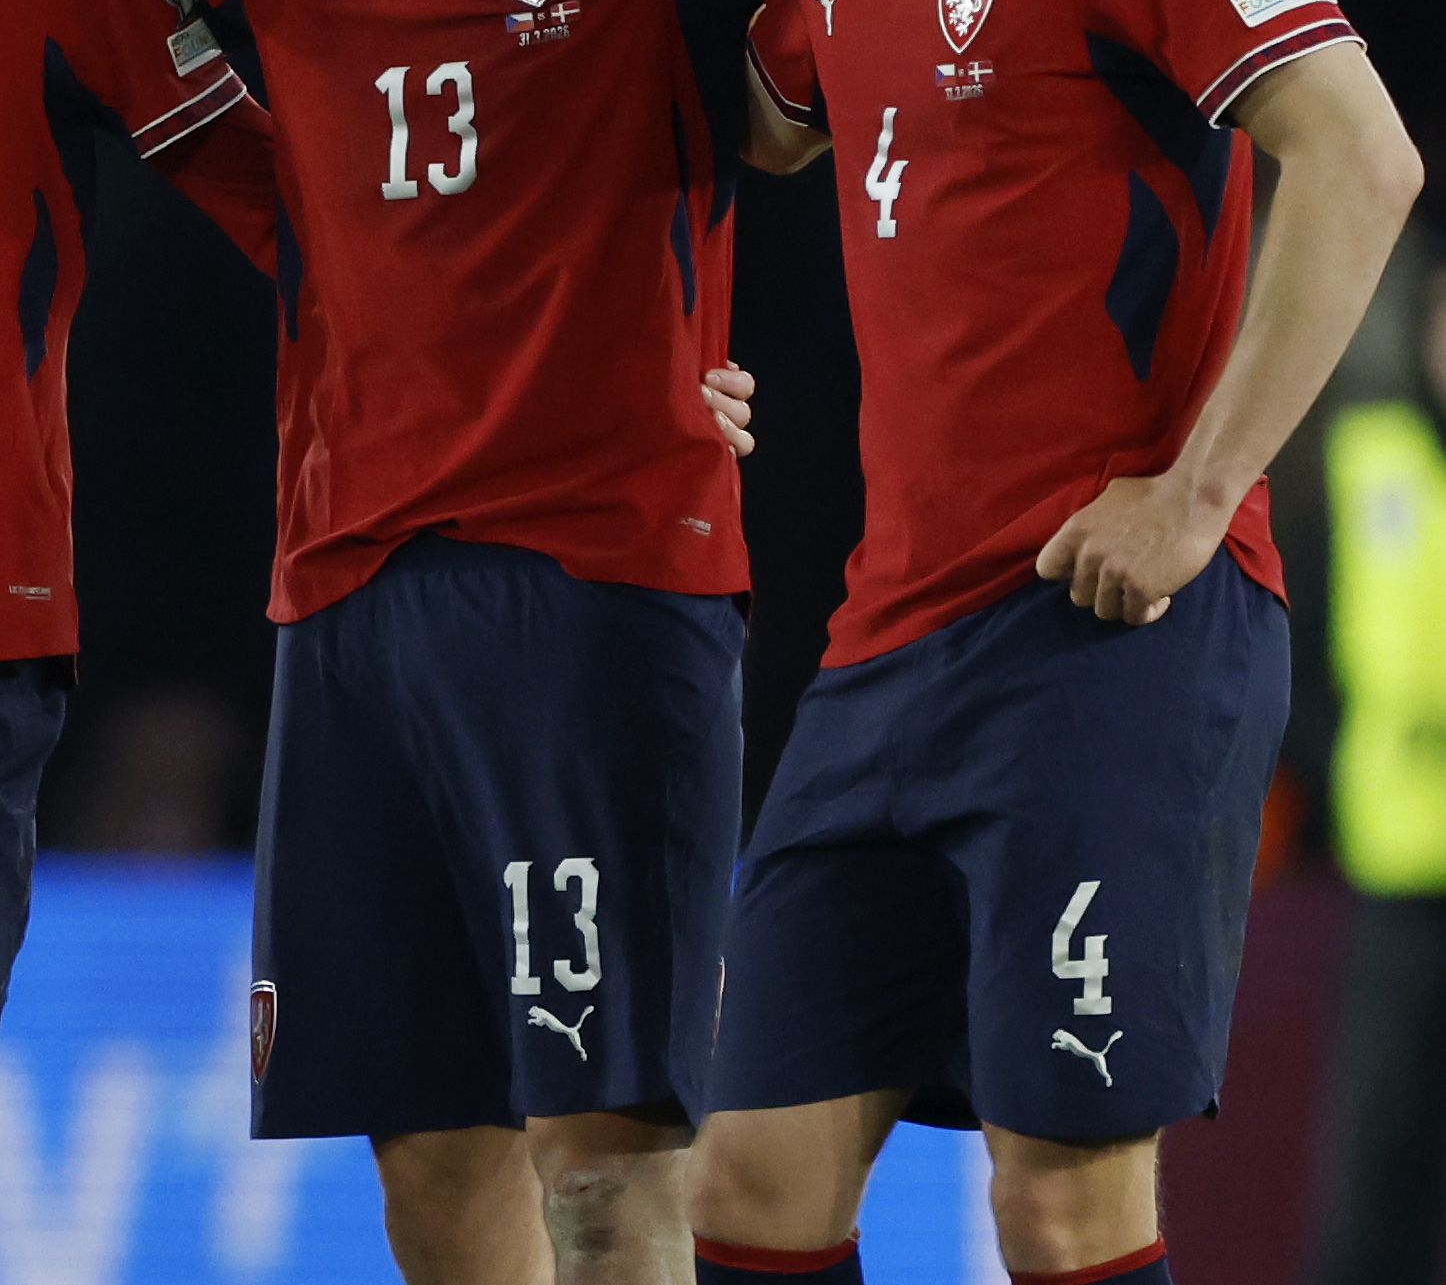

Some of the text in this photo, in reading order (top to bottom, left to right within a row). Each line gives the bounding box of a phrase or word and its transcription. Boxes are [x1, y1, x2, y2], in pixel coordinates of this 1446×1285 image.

[375, 61, 477, 199] 13
[865, 107, 909, 238] 4
[504, 858, 601, 995] 13
[1052, 881, 1111, 1015] 4
